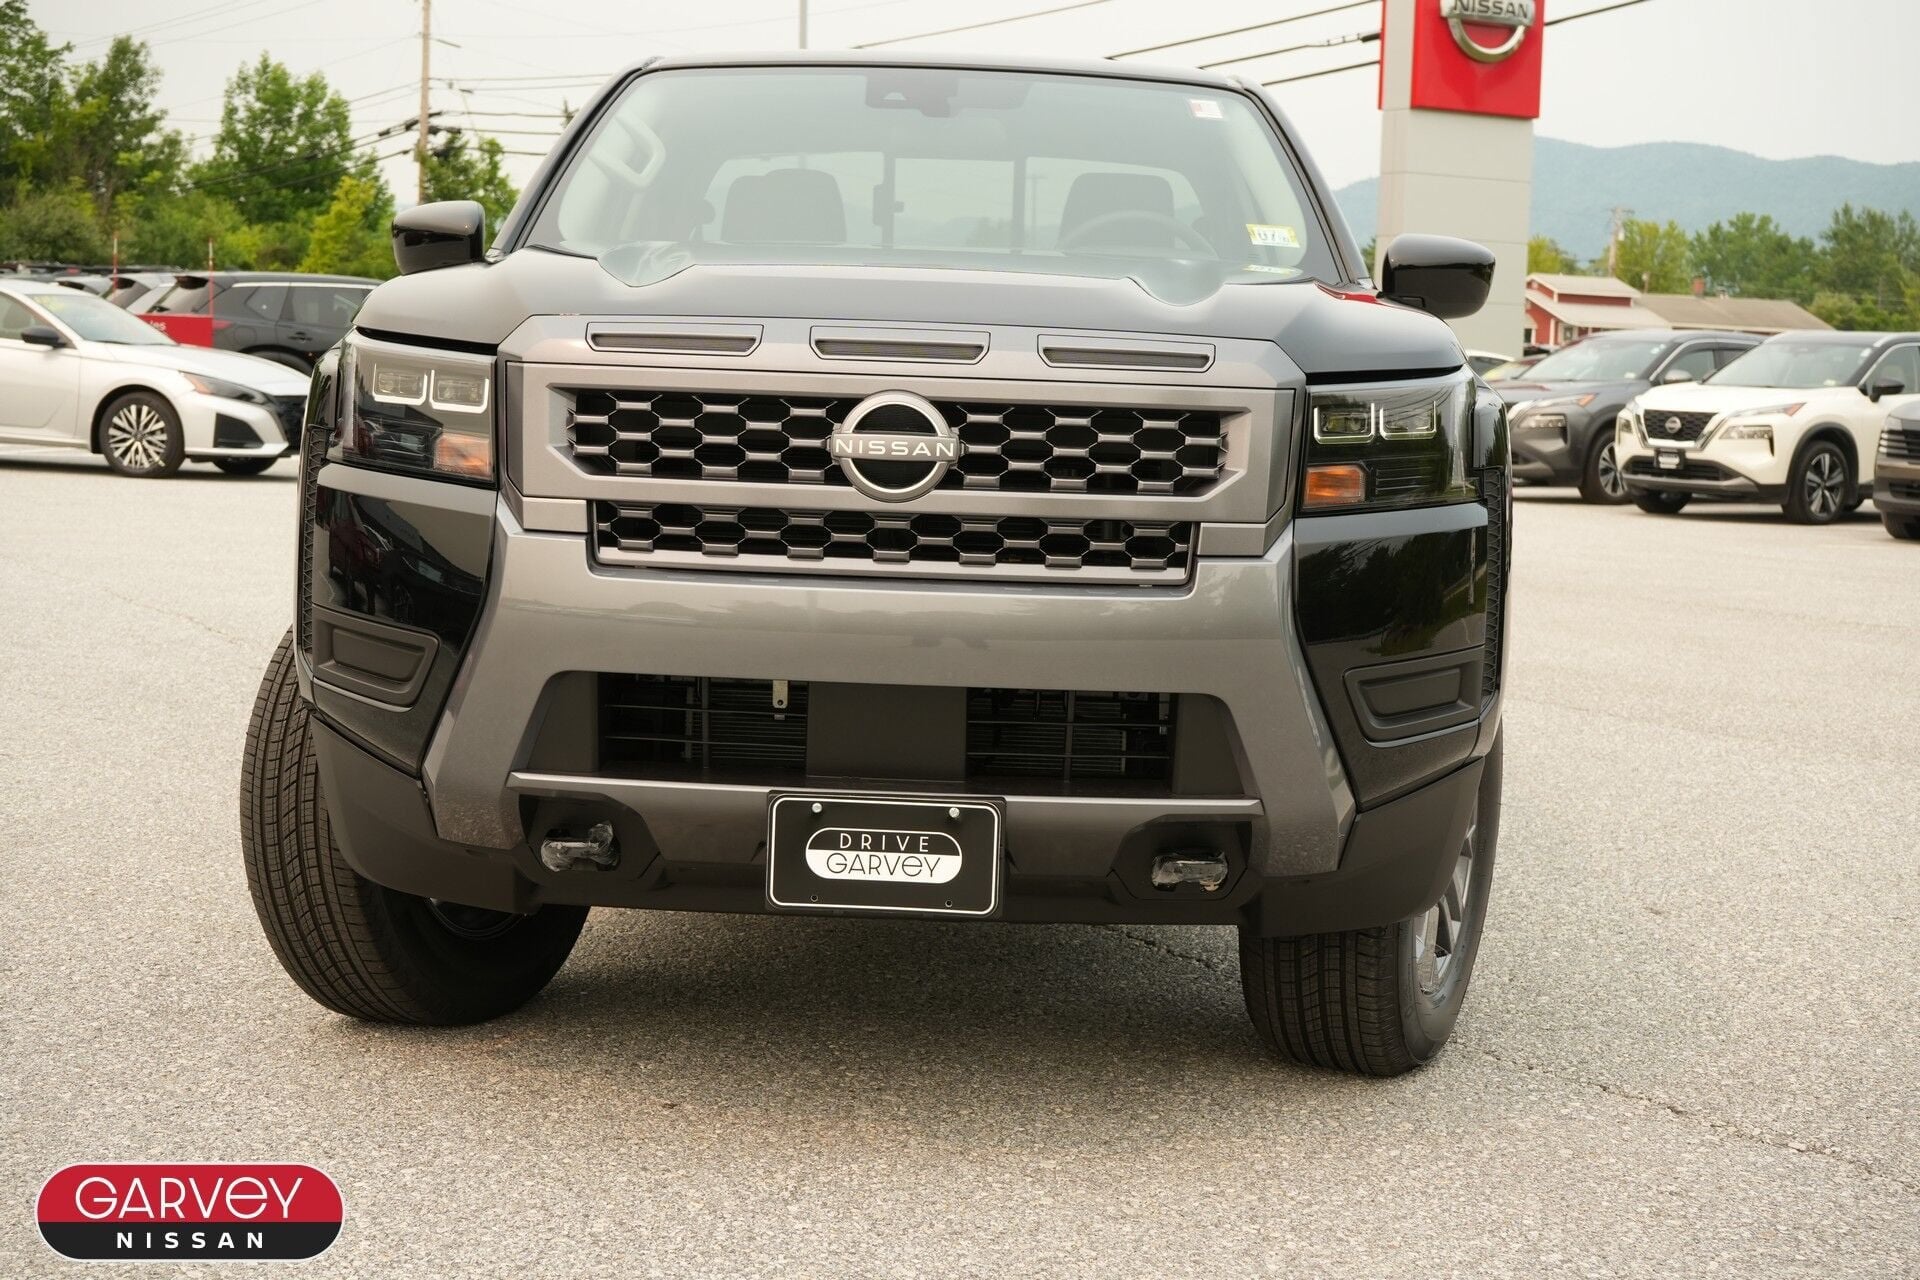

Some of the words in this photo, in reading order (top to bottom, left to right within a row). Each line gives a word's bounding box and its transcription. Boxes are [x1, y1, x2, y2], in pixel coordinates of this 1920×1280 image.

[1452, 0, 1529, 19] NISSAN
[835, 438, 954, 457] NISSAN
[839, 832, 929, 852] DRIVE
